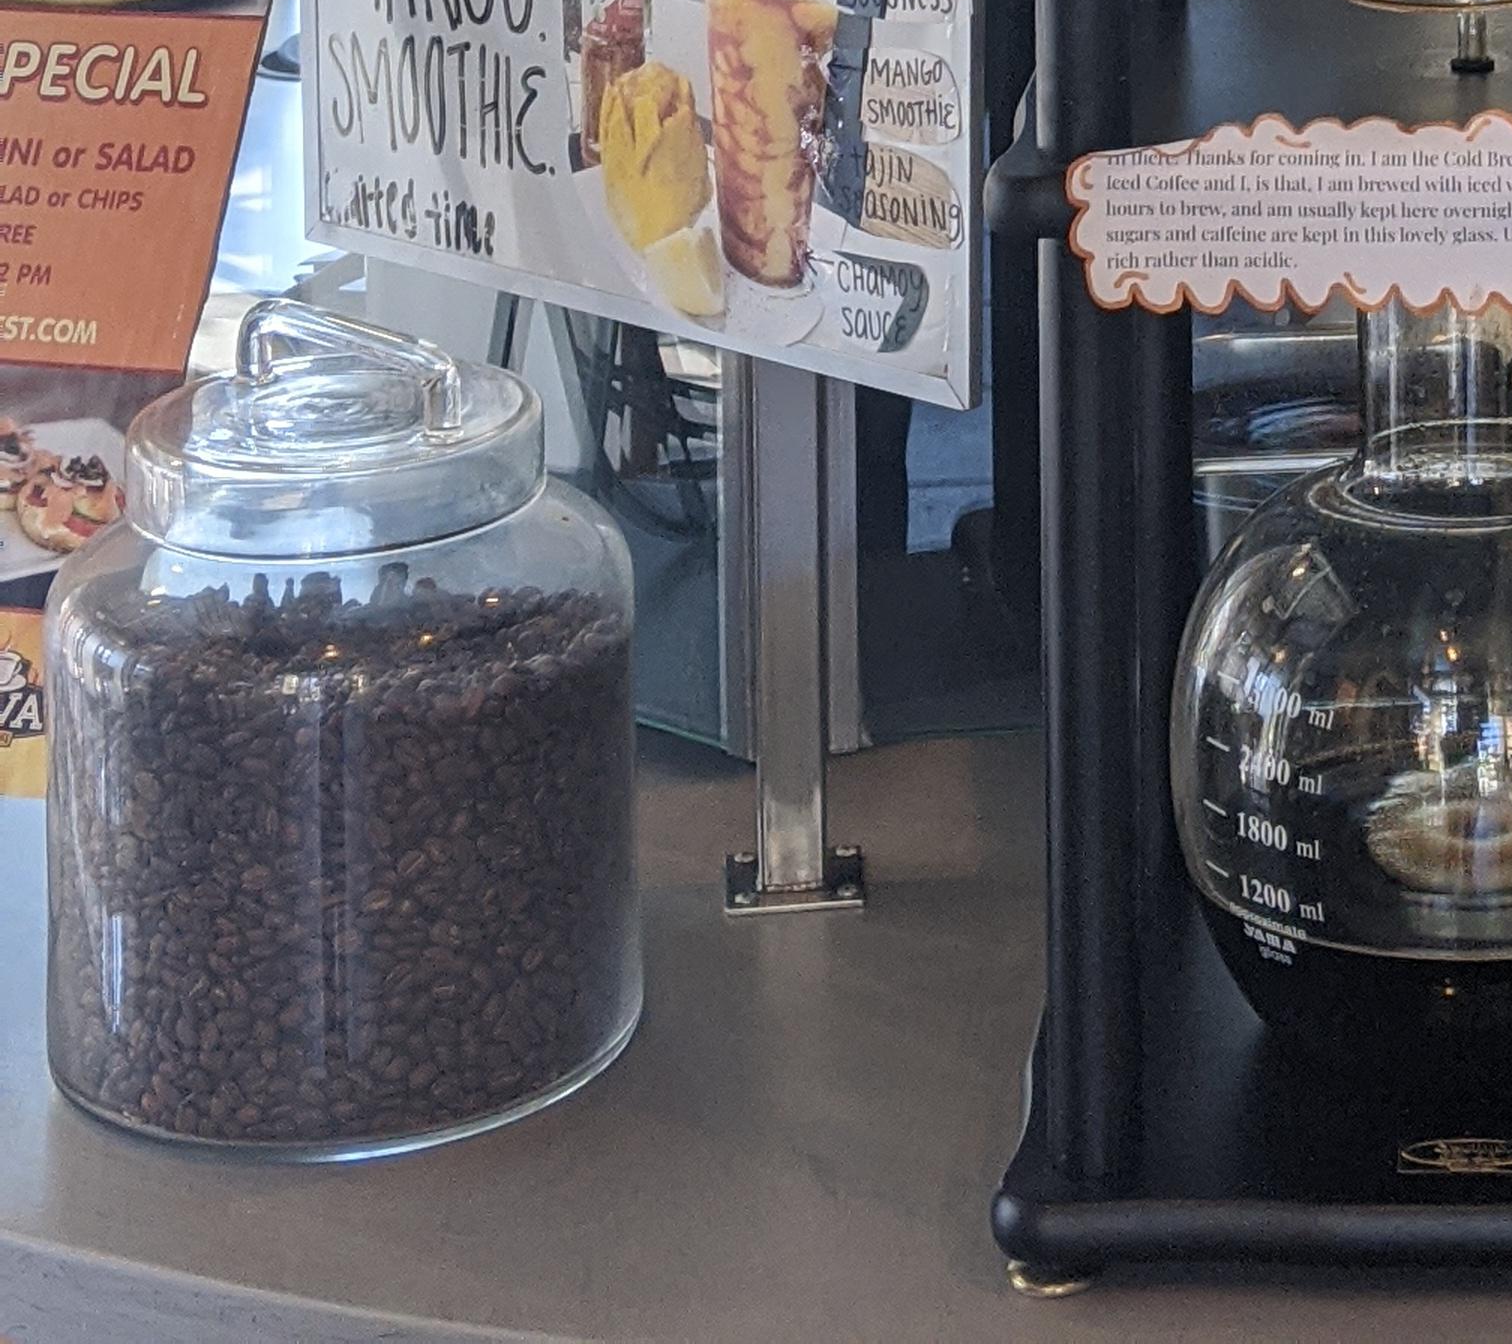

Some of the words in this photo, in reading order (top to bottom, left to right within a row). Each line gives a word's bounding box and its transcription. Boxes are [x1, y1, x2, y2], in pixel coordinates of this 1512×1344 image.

[0, 40, 208, 108] PECIAL
[869, 56, 945, 89] MANGO
[52, 146, 85, 170] or
[95, 142, 196, 175] SALAD
[1186, 150, 1246, 167] Thanks
[1250, 150, 1274, 167] for
[1278, 150, 1340, 170] coming
[1380, 155, 1408, 167] am
[1412, 150, 1440, 167] the
[1442, 150, 1482, 167] Cold
[47, 191, 70, 208] or
[77, 187, 144, 212] CHIPS
[1106, 175, 1140, 192] Iced
[1144, 175, 1200, 192] Coffee
[1204, 175, 1236, 192] and
[1256, 175, 1270, 192] is
[1326, 180, 1354, 192] am
[1358, 175, 1420, 192] brewed
[1424, 175, 1462, 192] with
[1466, 175, 1502, 192] iced
[1106, 200, 1154, 216] hours
[1158, 200, 1176, 216] to
[1180, 200, 1228, 218] brew,
[1230, 200, 1262, 216] and
[1266, 205, 1292, 216] am
[1296, 200, 1356, 219] usually
[1360, 200, 1396, 219] kept
[1400, 200, 1438, 216] here
[1106, 231, 1160, 245] sugars
[1164, 226, 1196, 242] and
[1200, 226, 1266, 242] caffeine
[1270, 231, 1298, 242] are
[1302, 226, 1338, 245] kept
[1342, 226, 1360, 242] in
[1364, 226, 1396, 242] this
[1398, 226, 1448, 245] lovely
[16, 263, 52, 286] PM
[1106, 252, 1140, 268] rich
[1144, 252, 1198, 268] rather
[1200, 252, 1238, 268] than
[1242, 252, 1298, 268] acidic.
[0, 315, 98, 347] ST.COM
[1247, 686, 1302, 719] 300
[1308, 707, 1334, 731] ml
[1239, 744, 1291, 786] 200
[1298, 774, 1323, 796] ml
[1237, 812, 1288, 852] 1800
[1296, 839, 1321, 861] ml
[1239, 874, 1291, 914] 1200
[1299, 902, 1325, 923] ml
